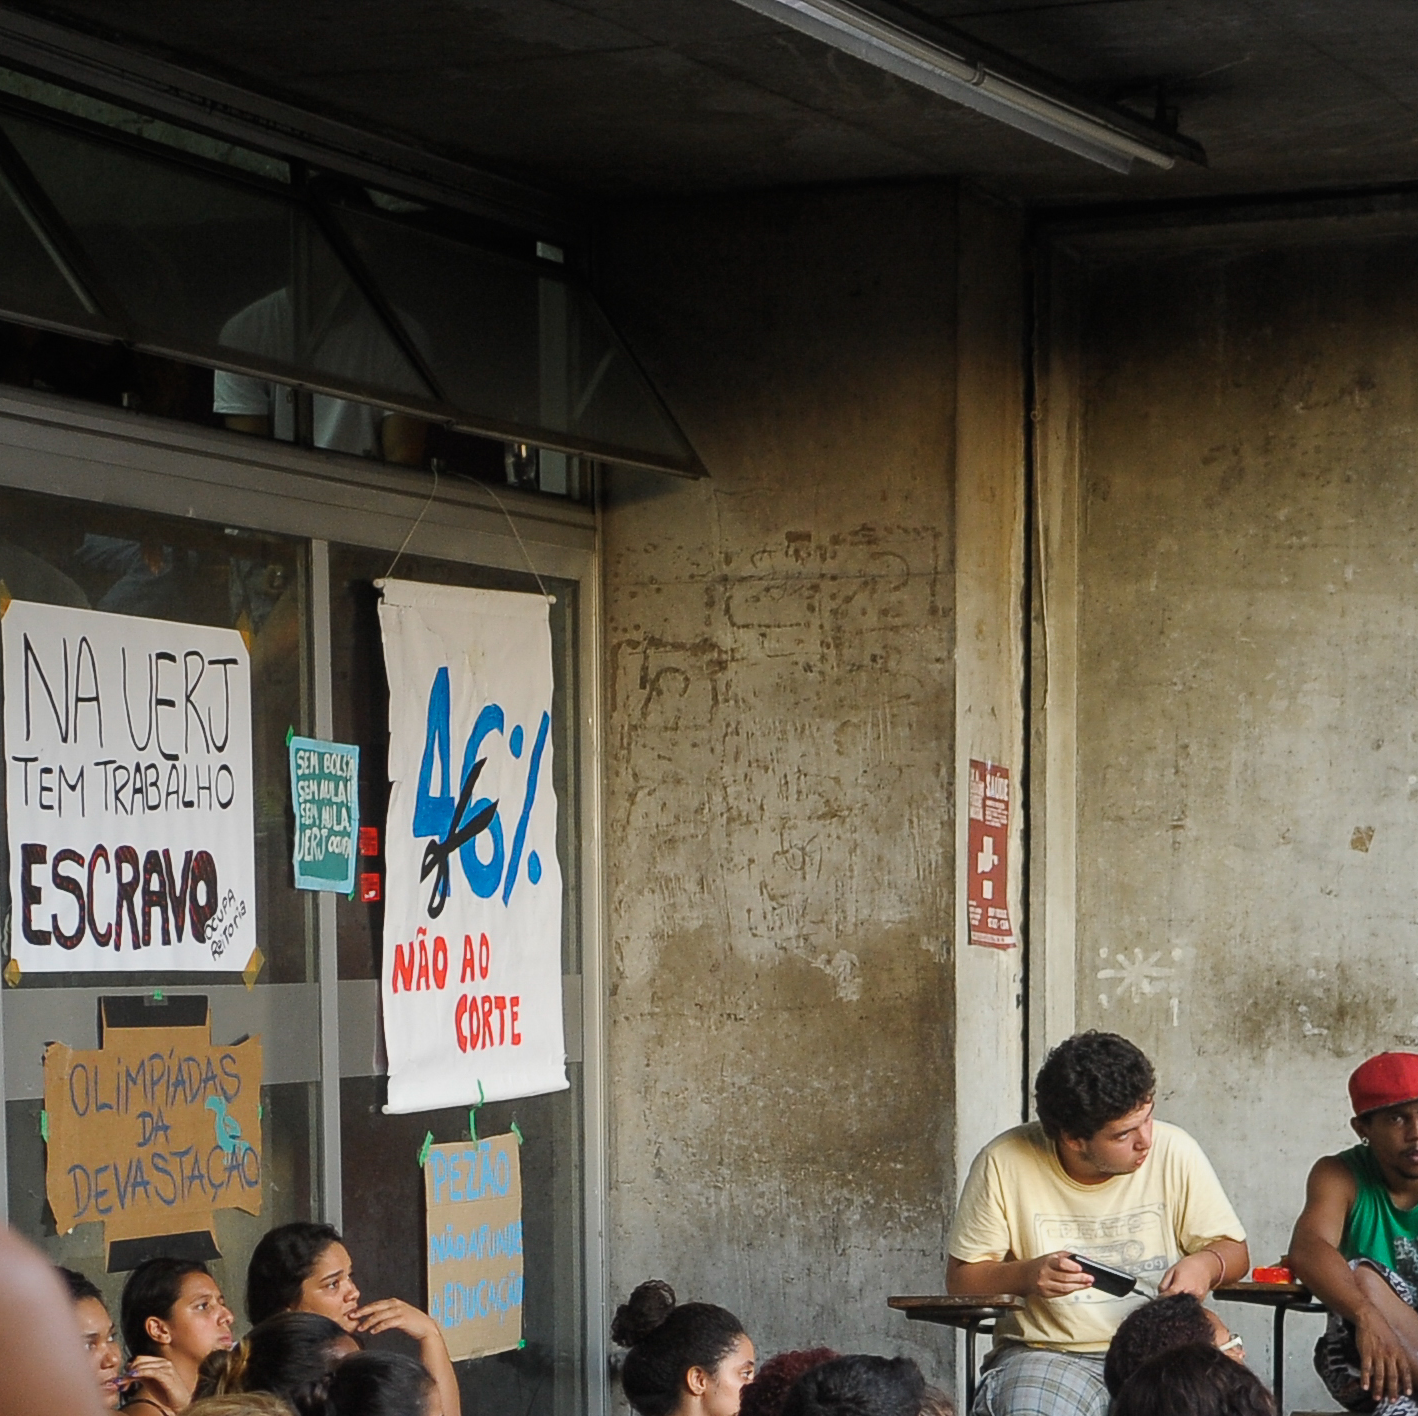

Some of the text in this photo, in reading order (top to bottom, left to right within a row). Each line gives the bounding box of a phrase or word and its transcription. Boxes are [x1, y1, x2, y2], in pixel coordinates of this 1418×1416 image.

[23, 632, 103, 748] NA
[122, 646, 239, 762] UERJ
[11, 755, 236, 818] TEM TRABALHO
[296, 749, 320, 776] SEM
[297, 778, 319, 803] SEM
[413, 665, 551, 909] 46%
[300, 802, 320, 827] SEM
[20, 842, 219, 952] ESCRAVO
[391, 925, 490, 995] NÃO AO
[455, 993, 522, 1053] CORTE
[68, 1047, 242, 1118] OLIMPÍADAS
[135, 1109, 171, 1149] DA
[428, 1141, 511, 1204] PEZÃO
